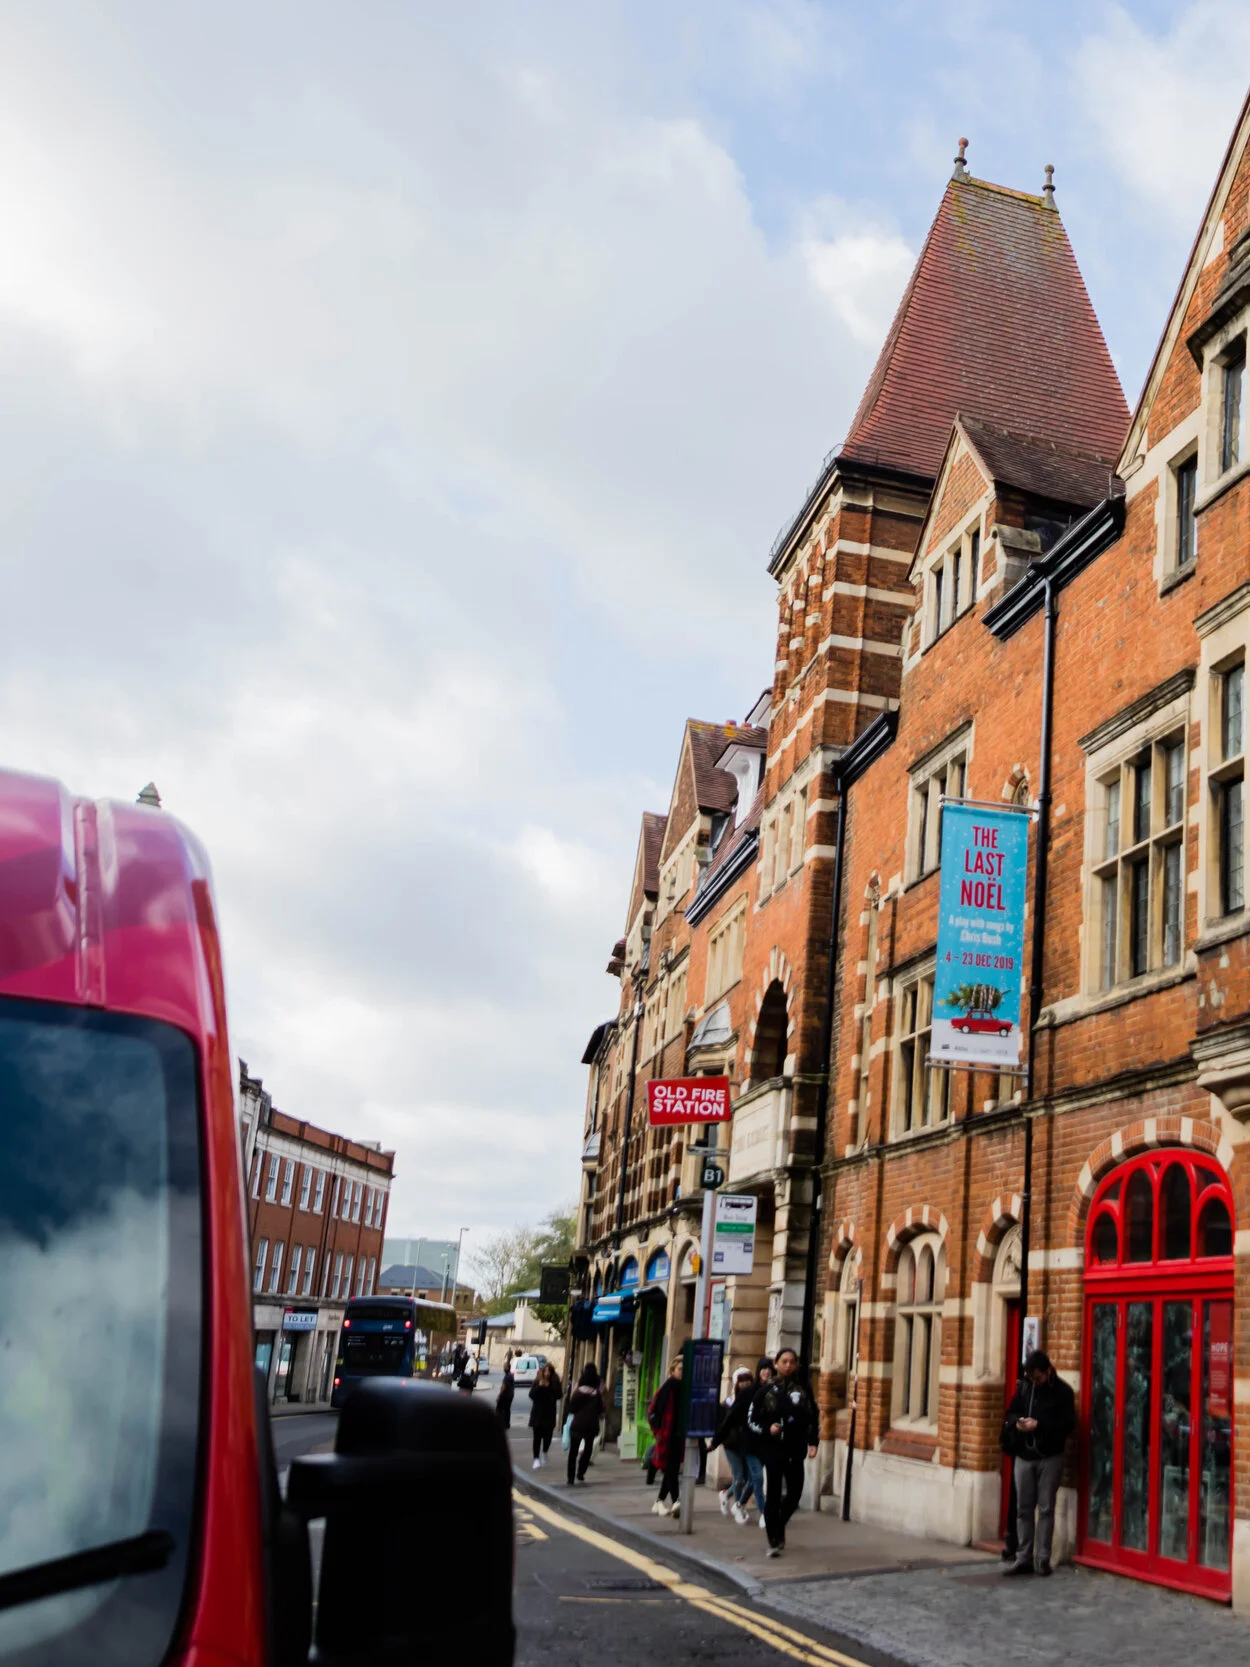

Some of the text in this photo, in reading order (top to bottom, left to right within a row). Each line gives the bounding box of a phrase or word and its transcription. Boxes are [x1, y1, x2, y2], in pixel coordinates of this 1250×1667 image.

[972, 826, 999, 849] THE
[965, 849, 1005, 877] LAST
[960, 877, 1006, 911] NOËL
[945, 952, 952, 963] 4
[962, 953, 973, 966] 23
[976, 953, 992, 968] DEC
[994, 955, 1014, 970] 2019
[654, 1085, 726, 1102] OLD FIRE
[653, 1098, 725, 1116] STATION
[704, 1169, 722, 1182] B1
[300, 1315, 315, 1323] LET
